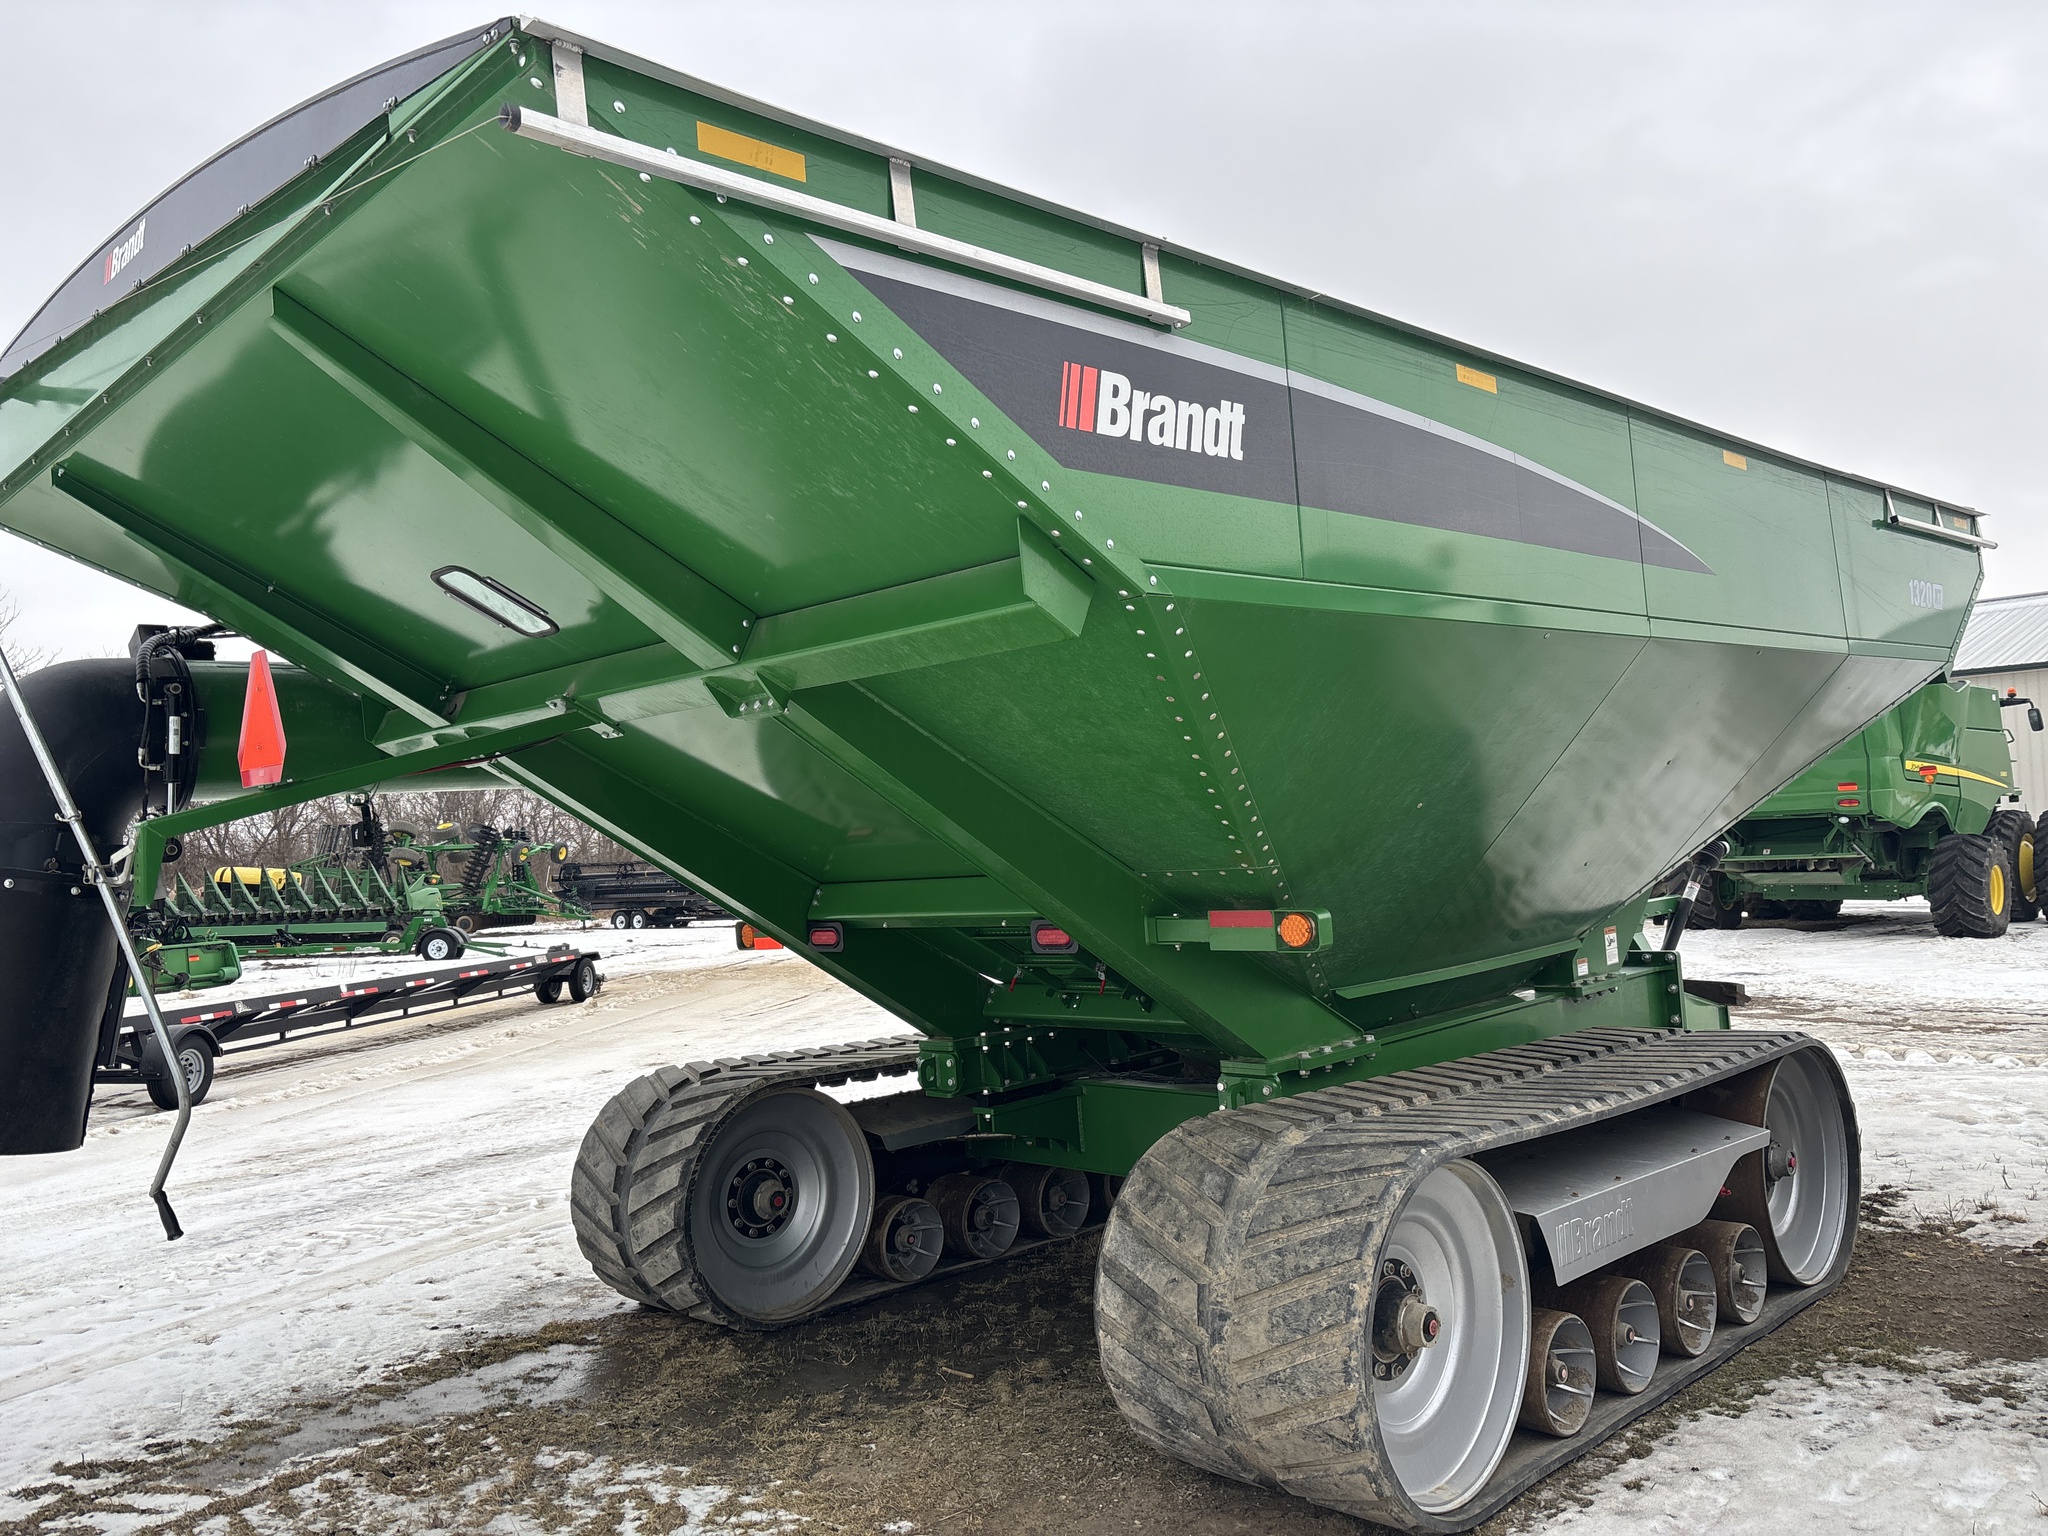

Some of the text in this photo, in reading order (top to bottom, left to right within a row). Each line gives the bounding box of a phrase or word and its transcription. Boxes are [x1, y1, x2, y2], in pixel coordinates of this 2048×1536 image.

[110, 217, 146, 281] Brandt
[1096, 369, 1246, 461] Brandt
[1908, 578, 1932, 609] 1320
[1570, 1197, 1634, 1262] Brandt
